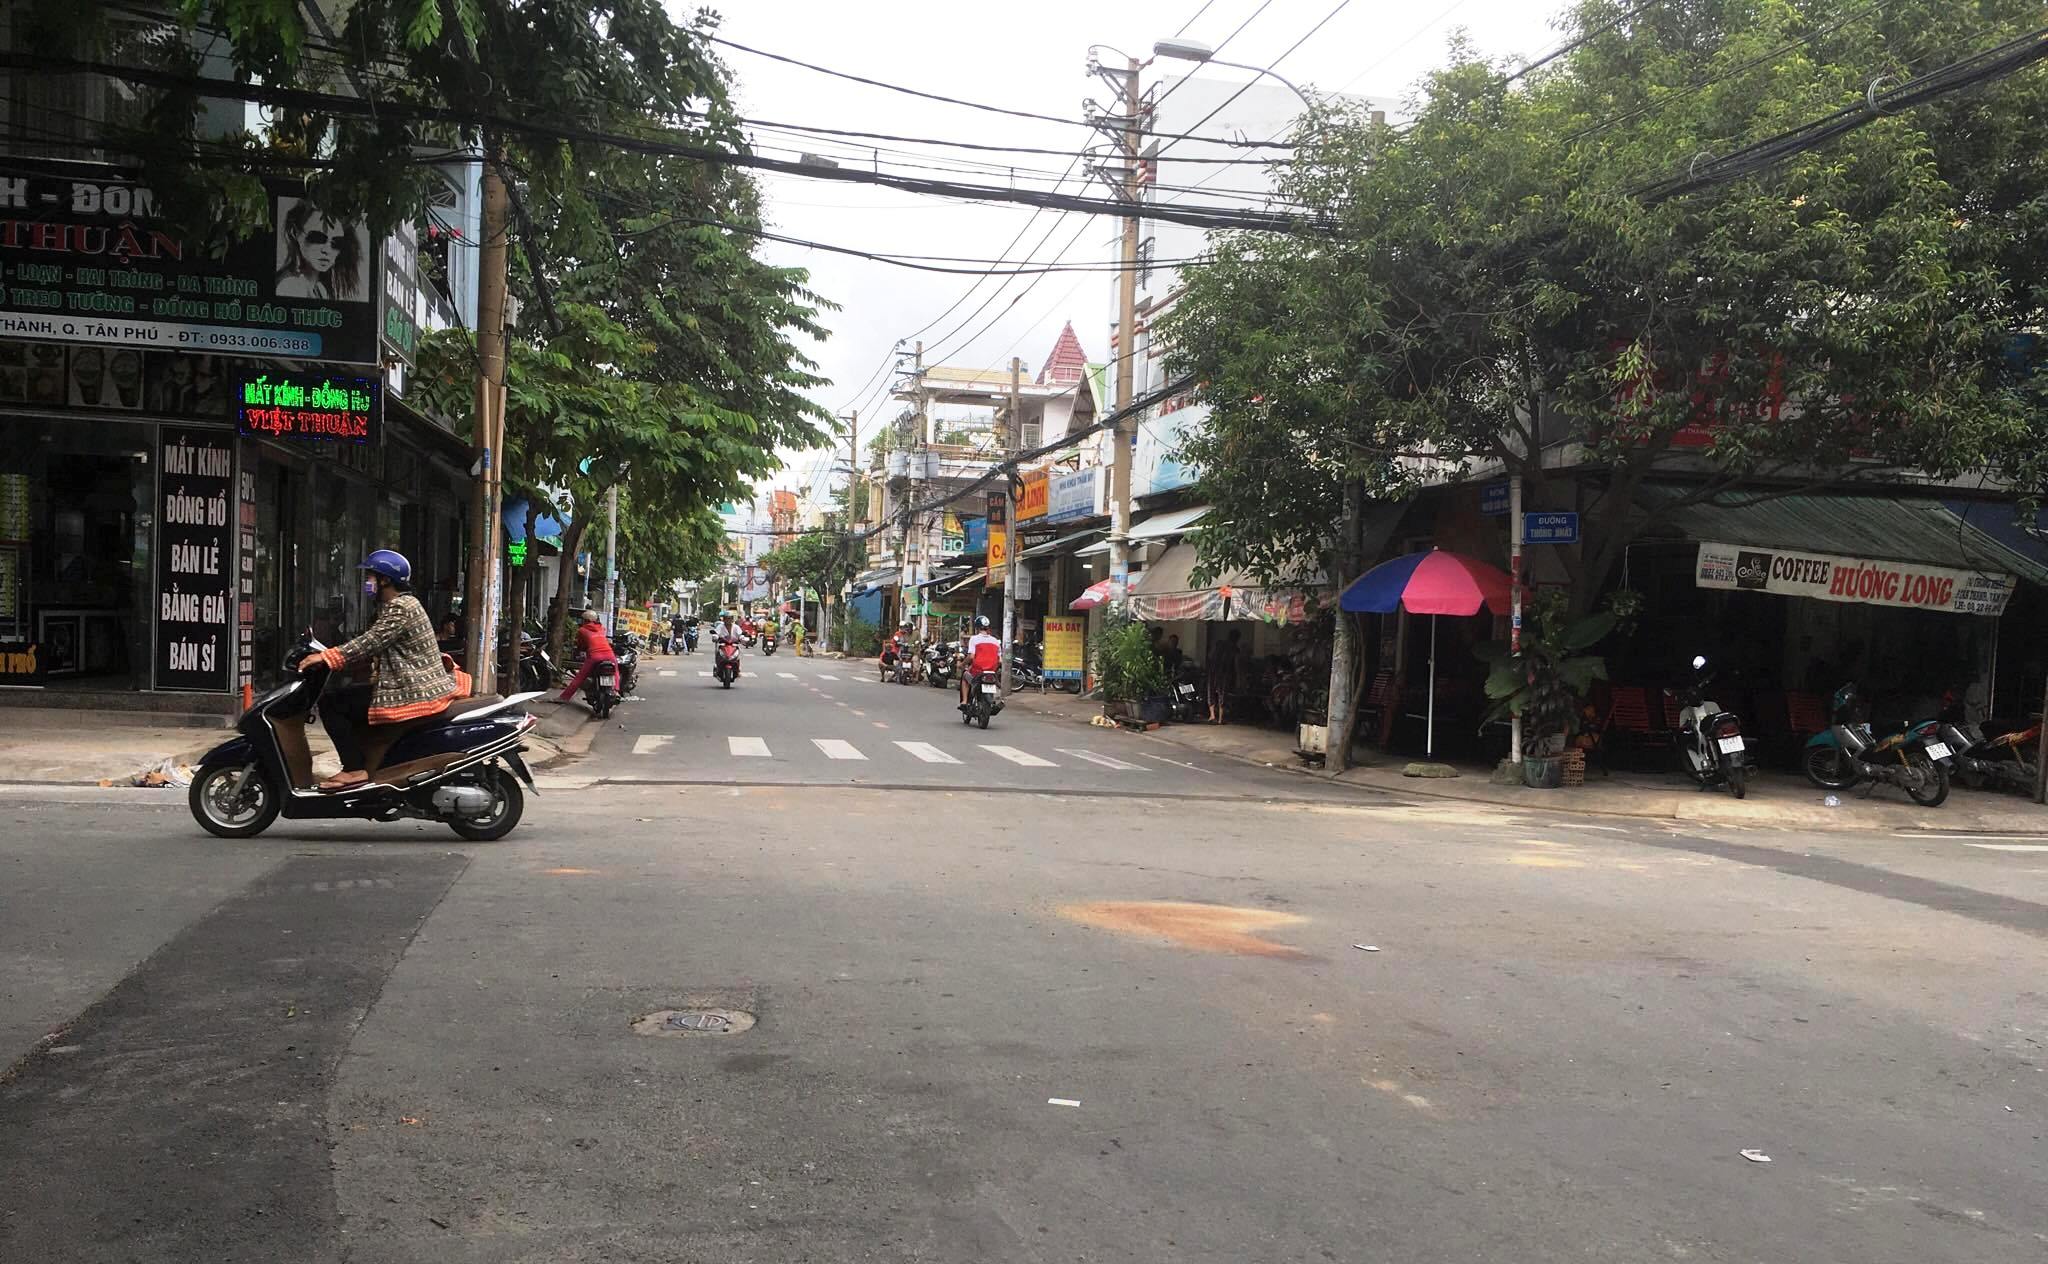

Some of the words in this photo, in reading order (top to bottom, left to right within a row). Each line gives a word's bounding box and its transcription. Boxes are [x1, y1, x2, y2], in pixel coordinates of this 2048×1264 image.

[75, 266, 105, 287] HAI
[10, 288, 62, 309] TREO
[62, 323, 79, 335] Q.
[85, 322, 118, 338] TÂN
[124, 326, 158, 341] PHÚ
[178, 331, 205, 344] ĐT:
[209, 333, 310, 352] 0933.006.388
[164, 436, 193, 475] MẮT
[197, 443, 231, 478] KÍNH
[165, 485, 204, 526] ĐỒNG
[207, 488, 226, 527] HỒ
[170, 537, 200, 574] BÁN
[202, 537, 220, 575] LẺ
[1772, 556, 1831, 585] COFFEE
[1900, 573, 1954, 606] LONG
[161, 583, 199, 623] BẰNG
[202, 591, 226, 625] GIÁ
[168, 636, 198, 672] BÁN
[201, 634, 217, 673] SỈ
